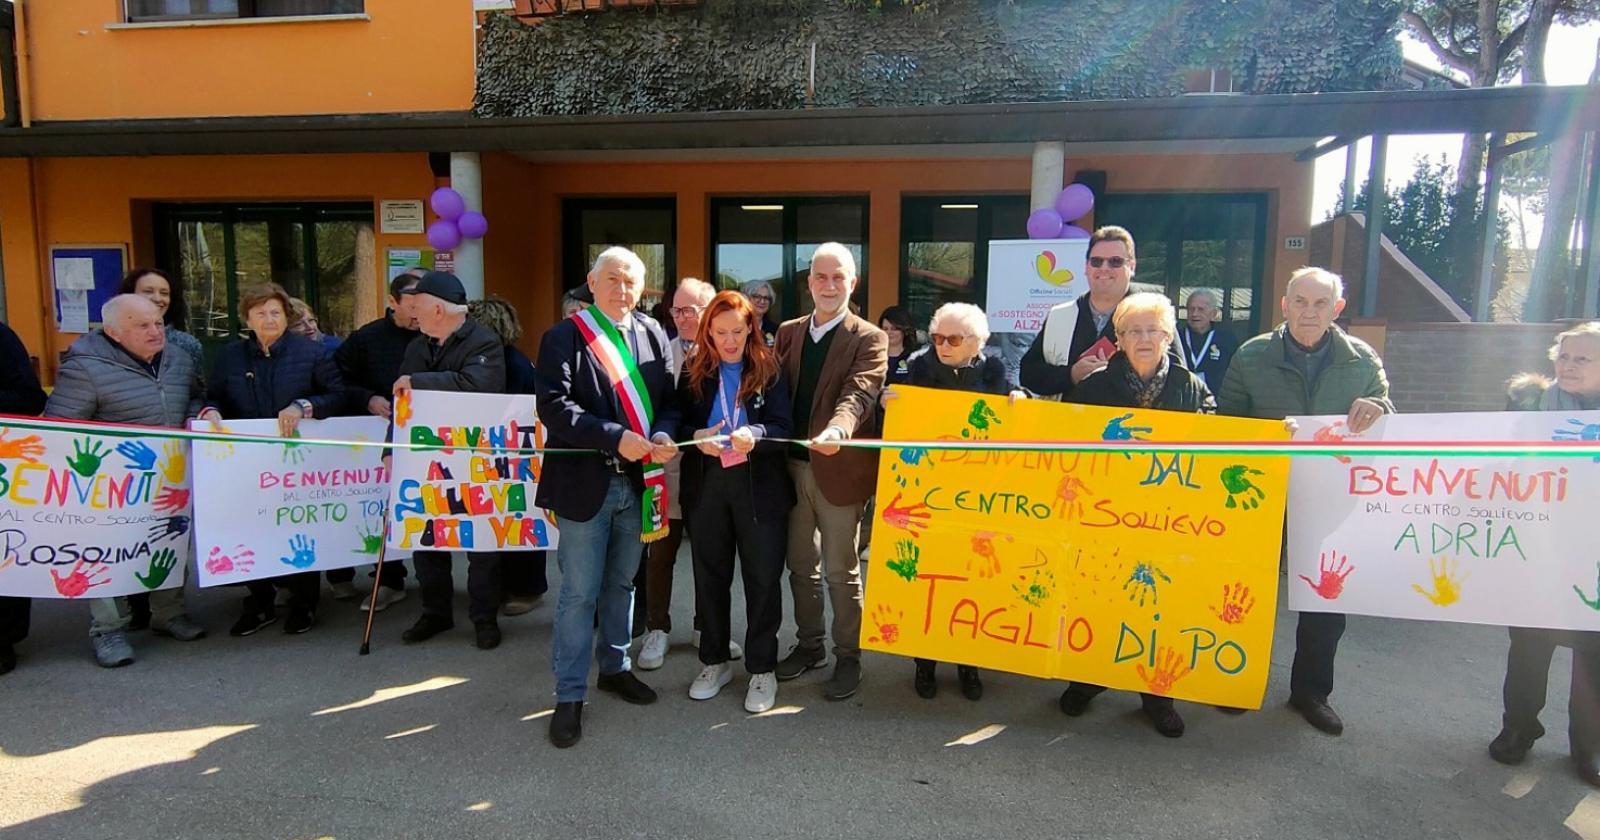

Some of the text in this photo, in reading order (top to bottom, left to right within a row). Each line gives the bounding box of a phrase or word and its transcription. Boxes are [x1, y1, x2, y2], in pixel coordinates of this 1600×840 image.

[1288, 239, 1303, 248] 155
[1029, 288, 1053, 296] Officine
[998, 310, 1044, 318] SOSTEGNO
[1014, 319, 1043, 330] ALZH
[1140, 449, 1201, 489] DAL
[924, 487, 1051, 520] CENTRO
[1366, 501, 1391, 514] DAL
[1402, 503, 1460, 517] CENTRO
[0, 509, 24, 522] AL
[33, 510, 96, 524] CENTRO
[276, 502, 348, 527] PORTO
[400, 517, 474, 549] PORTO
[0, 529, 150, 566] ROSOLINA
[1179, 627, 1247, 675] PO
